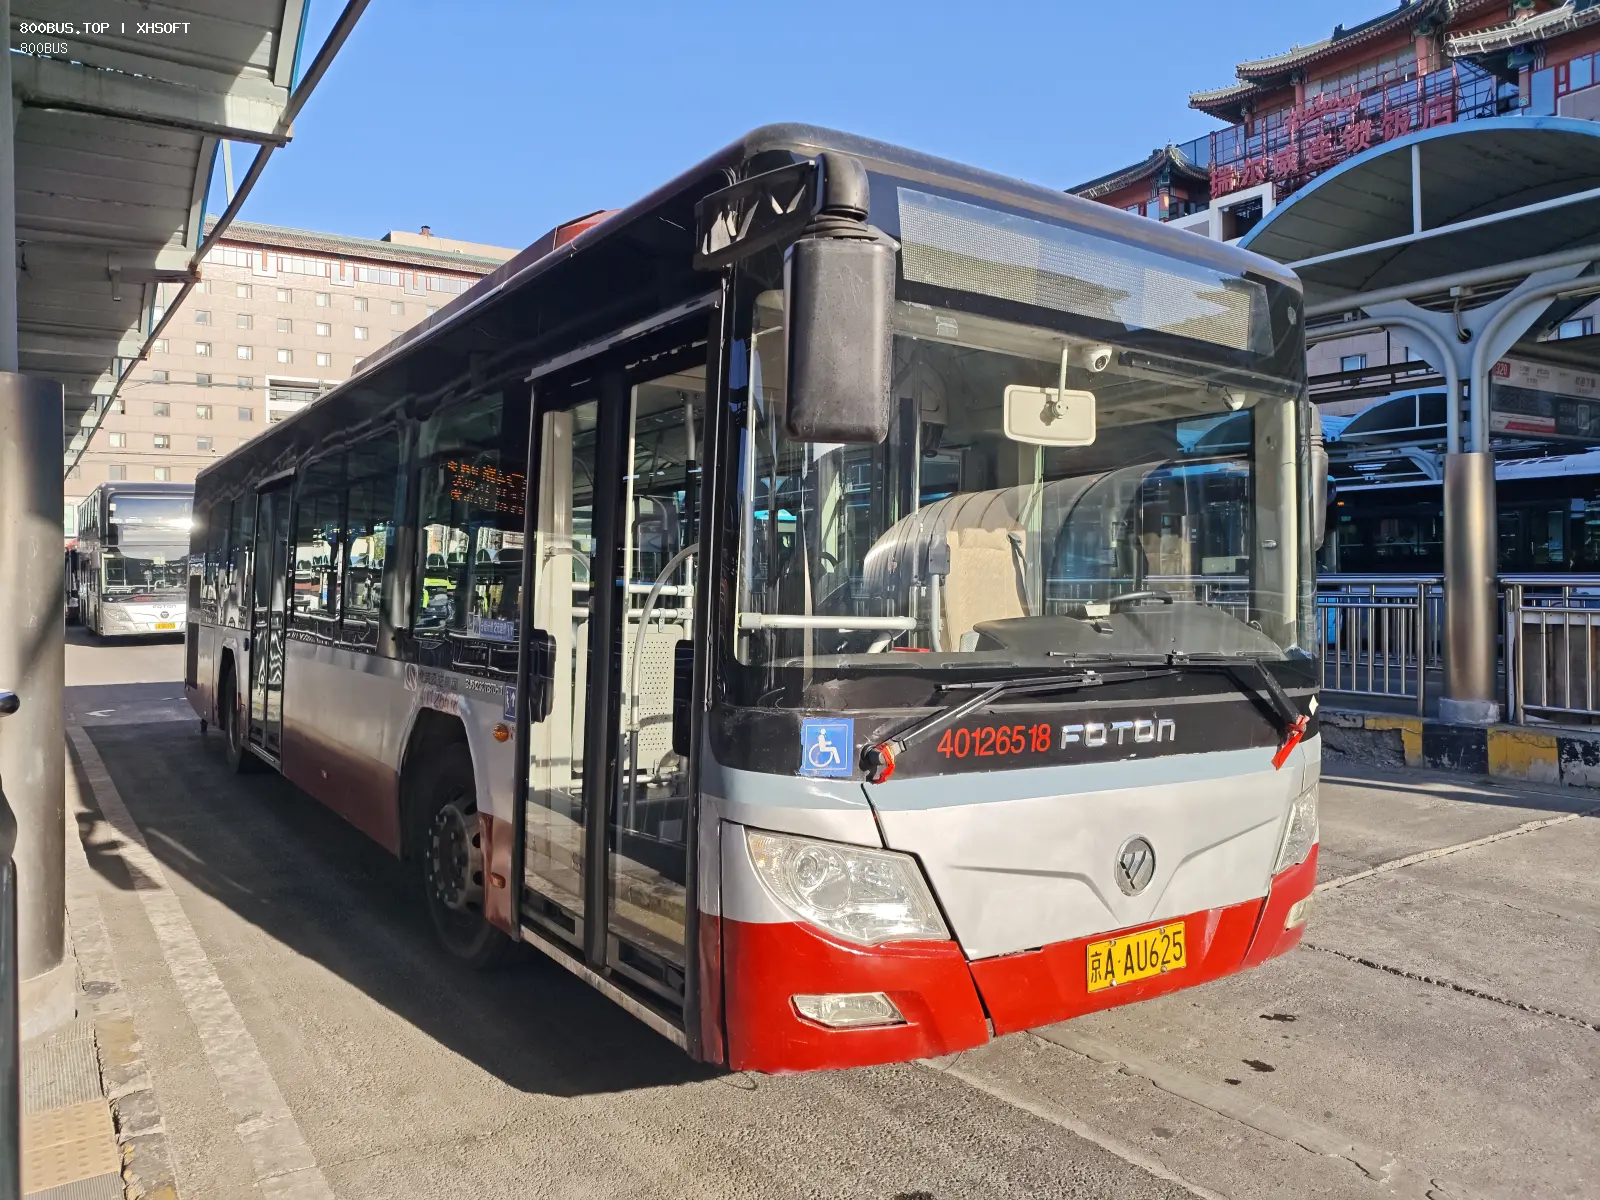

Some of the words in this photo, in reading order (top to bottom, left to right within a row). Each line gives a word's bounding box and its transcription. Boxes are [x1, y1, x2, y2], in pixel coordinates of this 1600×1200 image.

[1210, 96, 1454, 199] 瑞尔威连锁饭店
[937, 723, 1051, 758] 40126518
